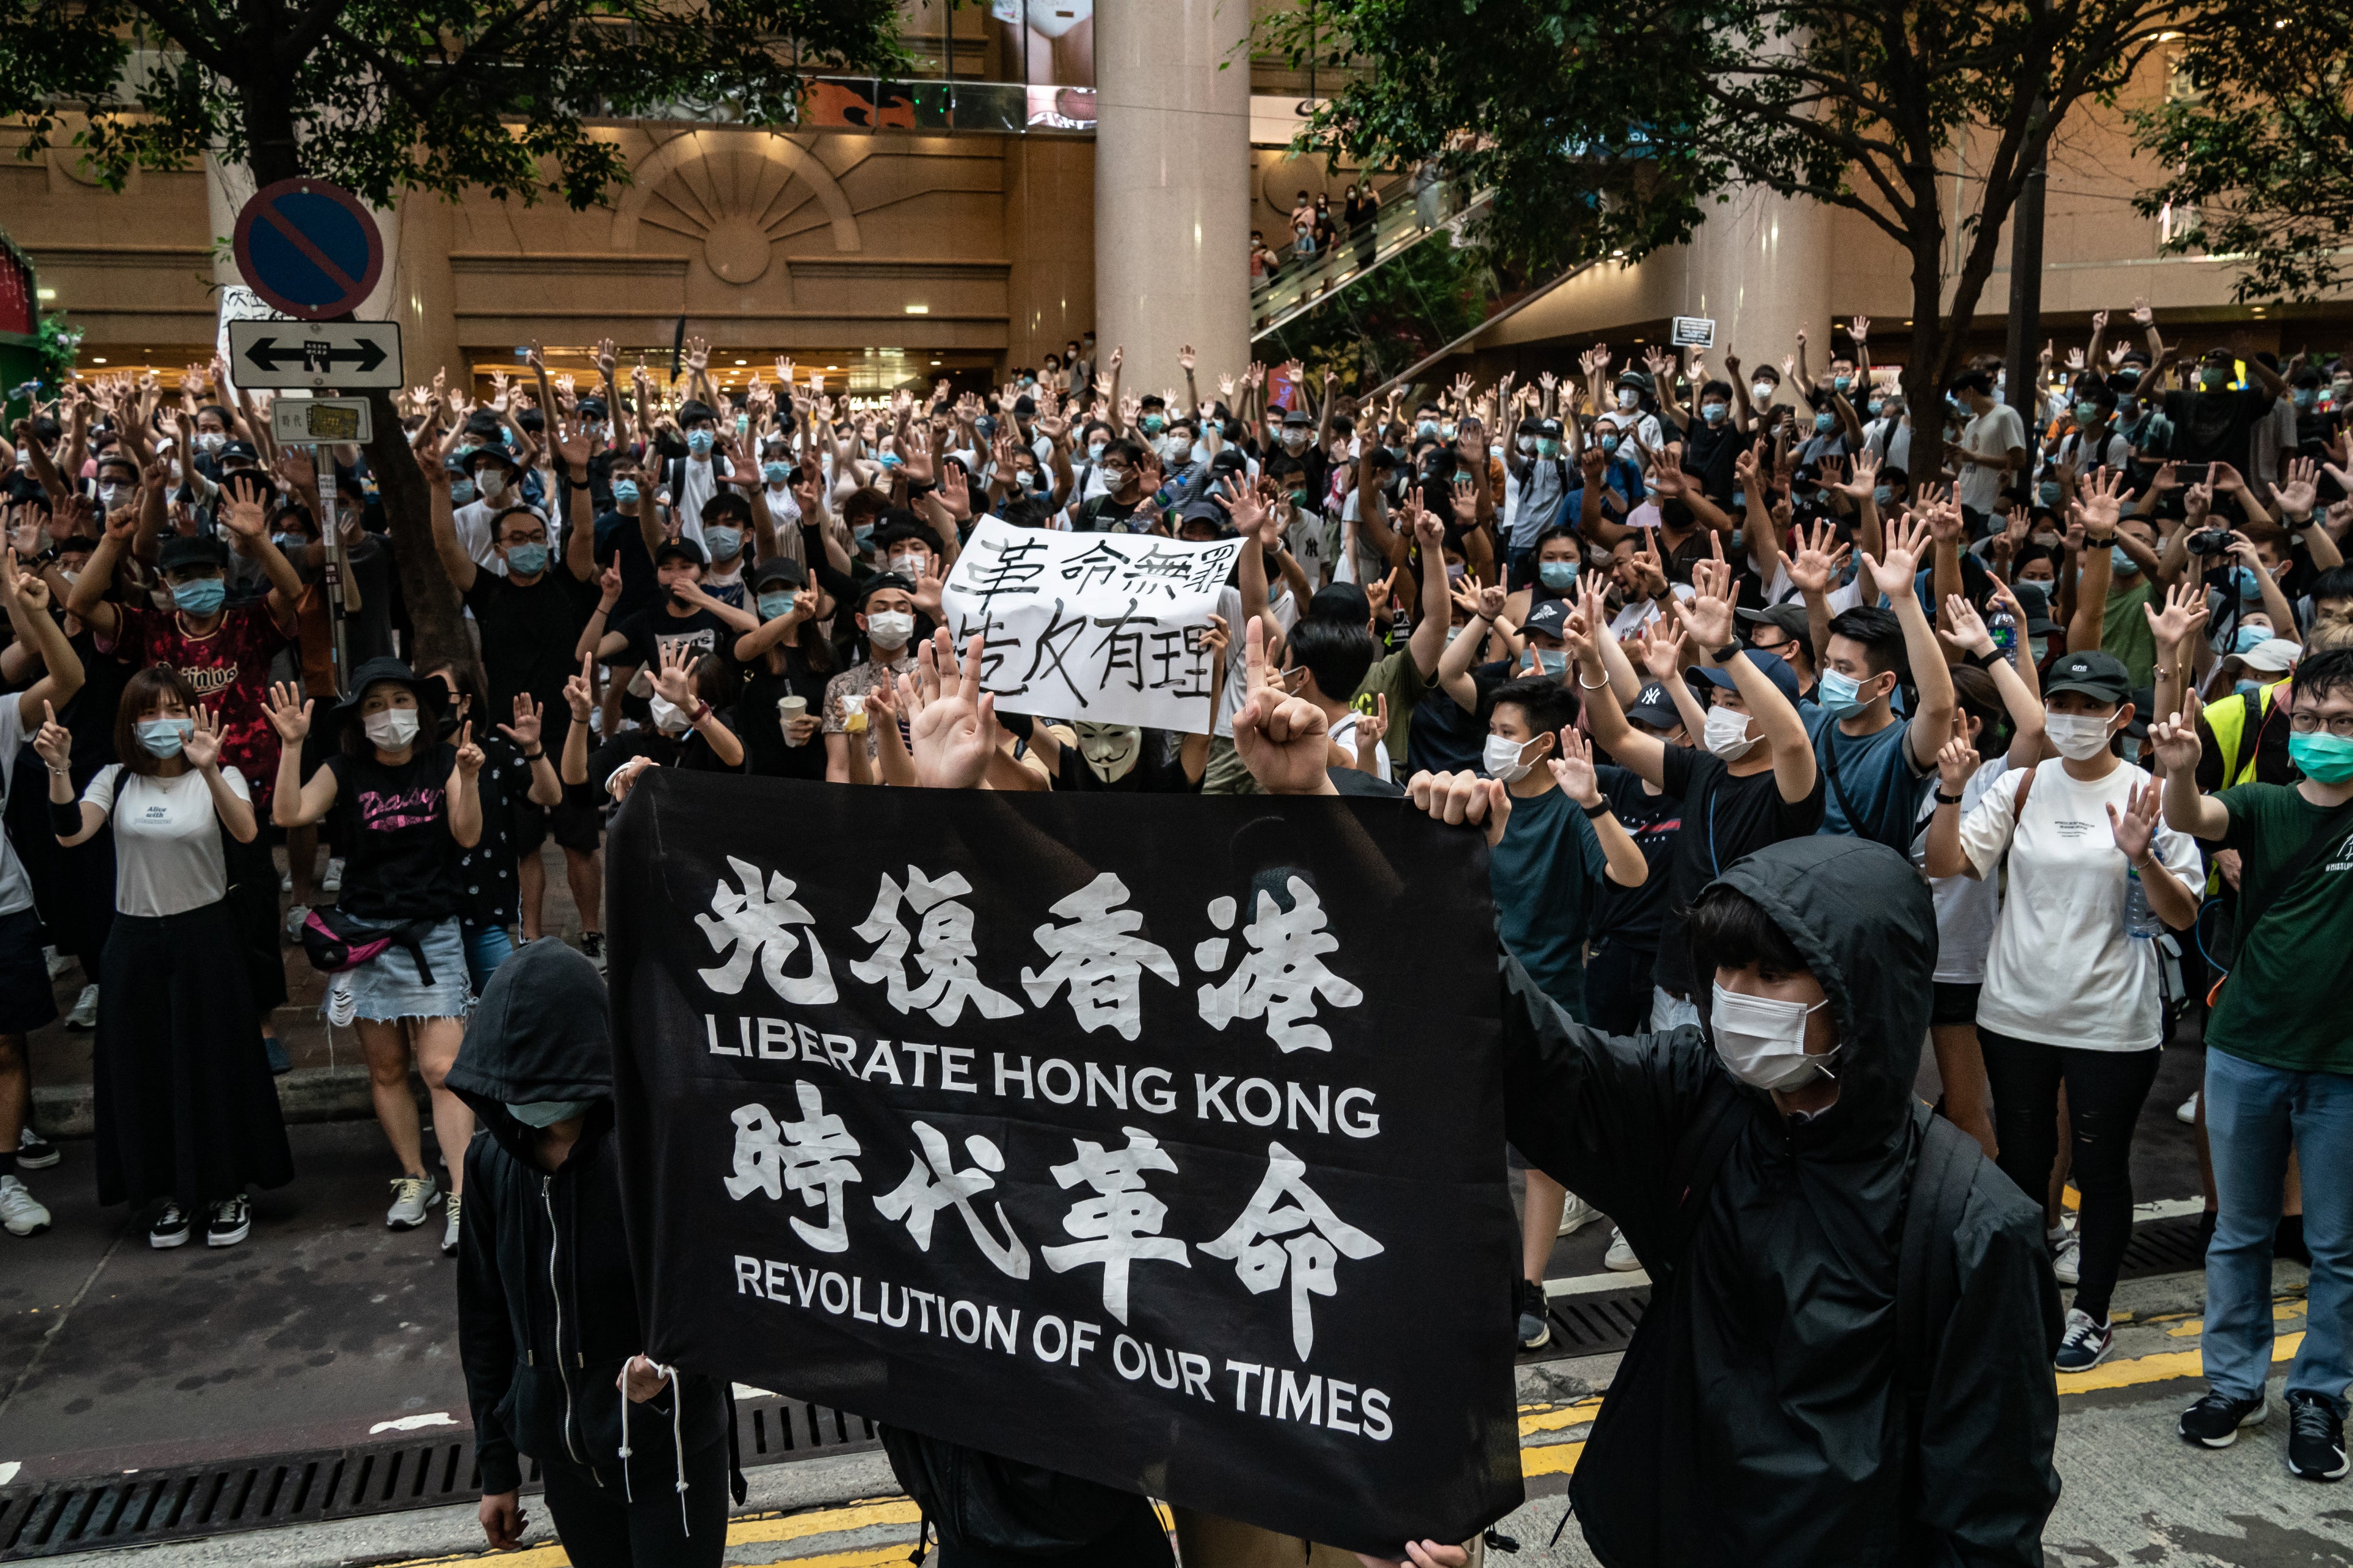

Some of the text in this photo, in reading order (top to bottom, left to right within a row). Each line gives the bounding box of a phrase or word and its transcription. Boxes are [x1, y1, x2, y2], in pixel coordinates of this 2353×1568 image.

[950, 536, 1238, 616] 革命無罪
[1641, 687, 1661, 705] NY
[358, 787, 445, 820] Daisy
[695, 855, 1363, 1053] 光復香港
[704, 1014, 1380, 1138] LIBERATE HONG KONG
[723, 1079, 1385, 1362] 時代革命
[734, 1254, 1393, 1441] REVOLUTION OF OUR TIMES
